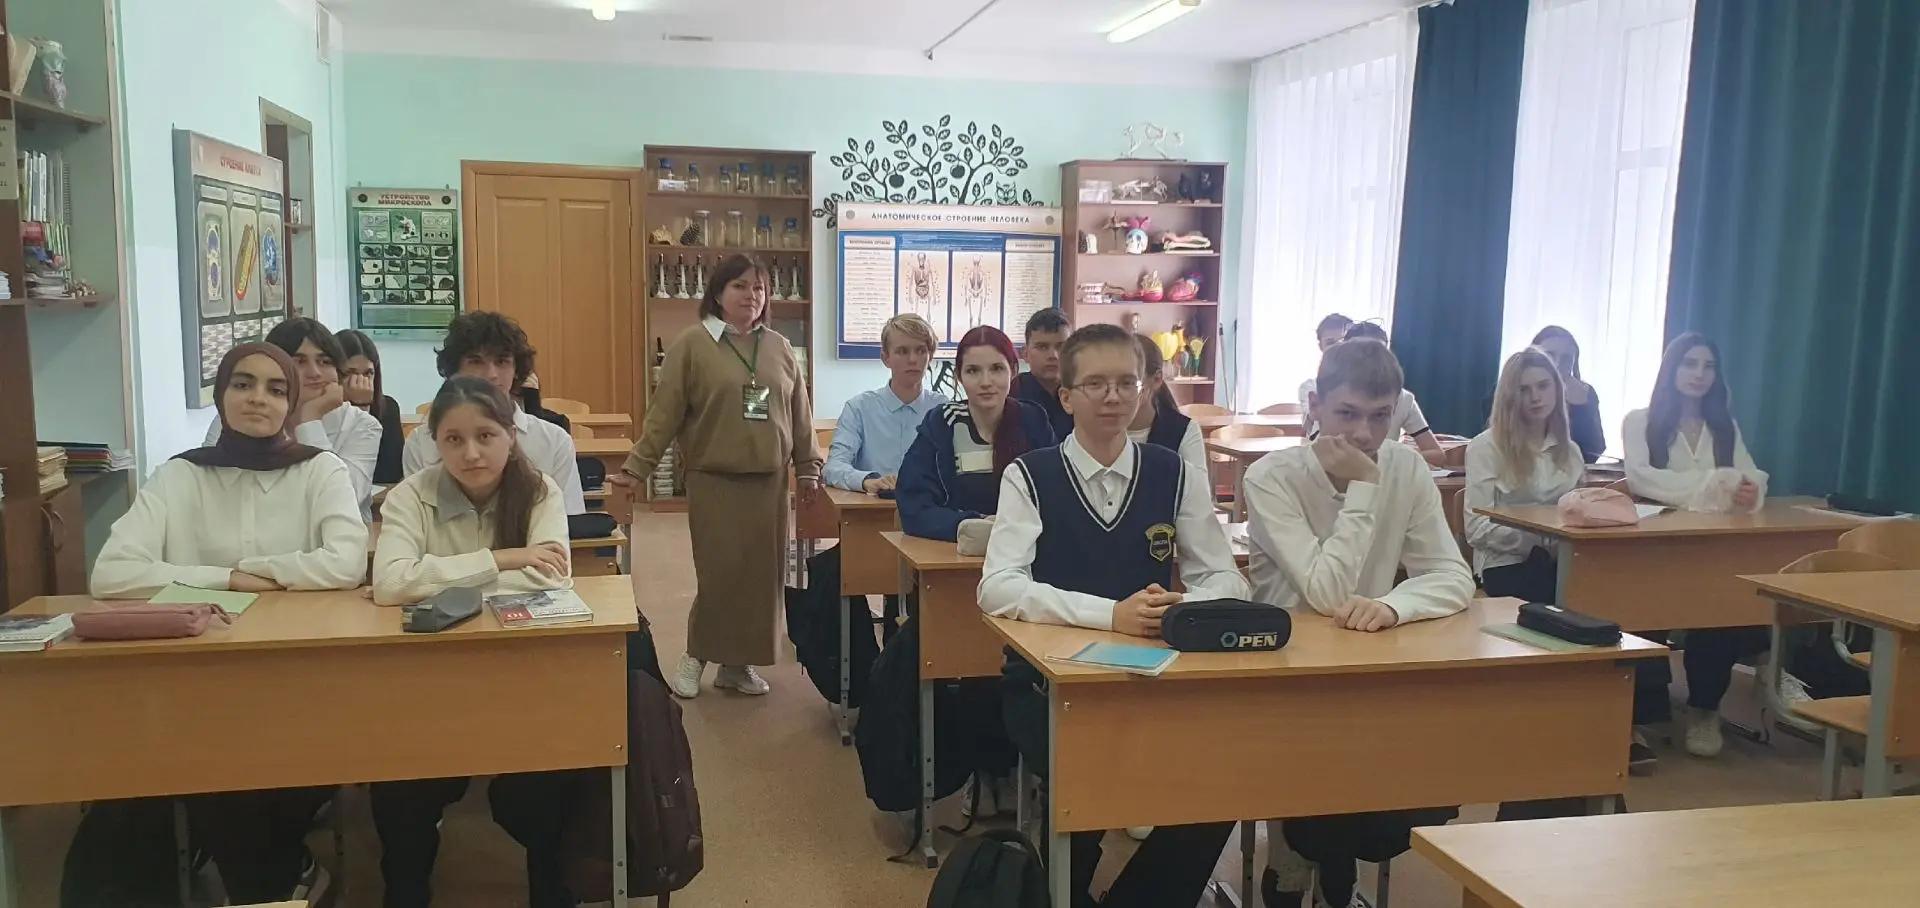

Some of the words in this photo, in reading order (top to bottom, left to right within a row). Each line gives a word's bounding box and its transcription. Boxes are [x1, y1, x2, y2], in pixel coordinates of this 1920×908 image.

[871, 212, 942, 221] АНАТОМИЧЕСКОЕ
[946, 215, 986, 223] СТРОЕНИЕ
[1221, 632, 1278, 648] OPEN
